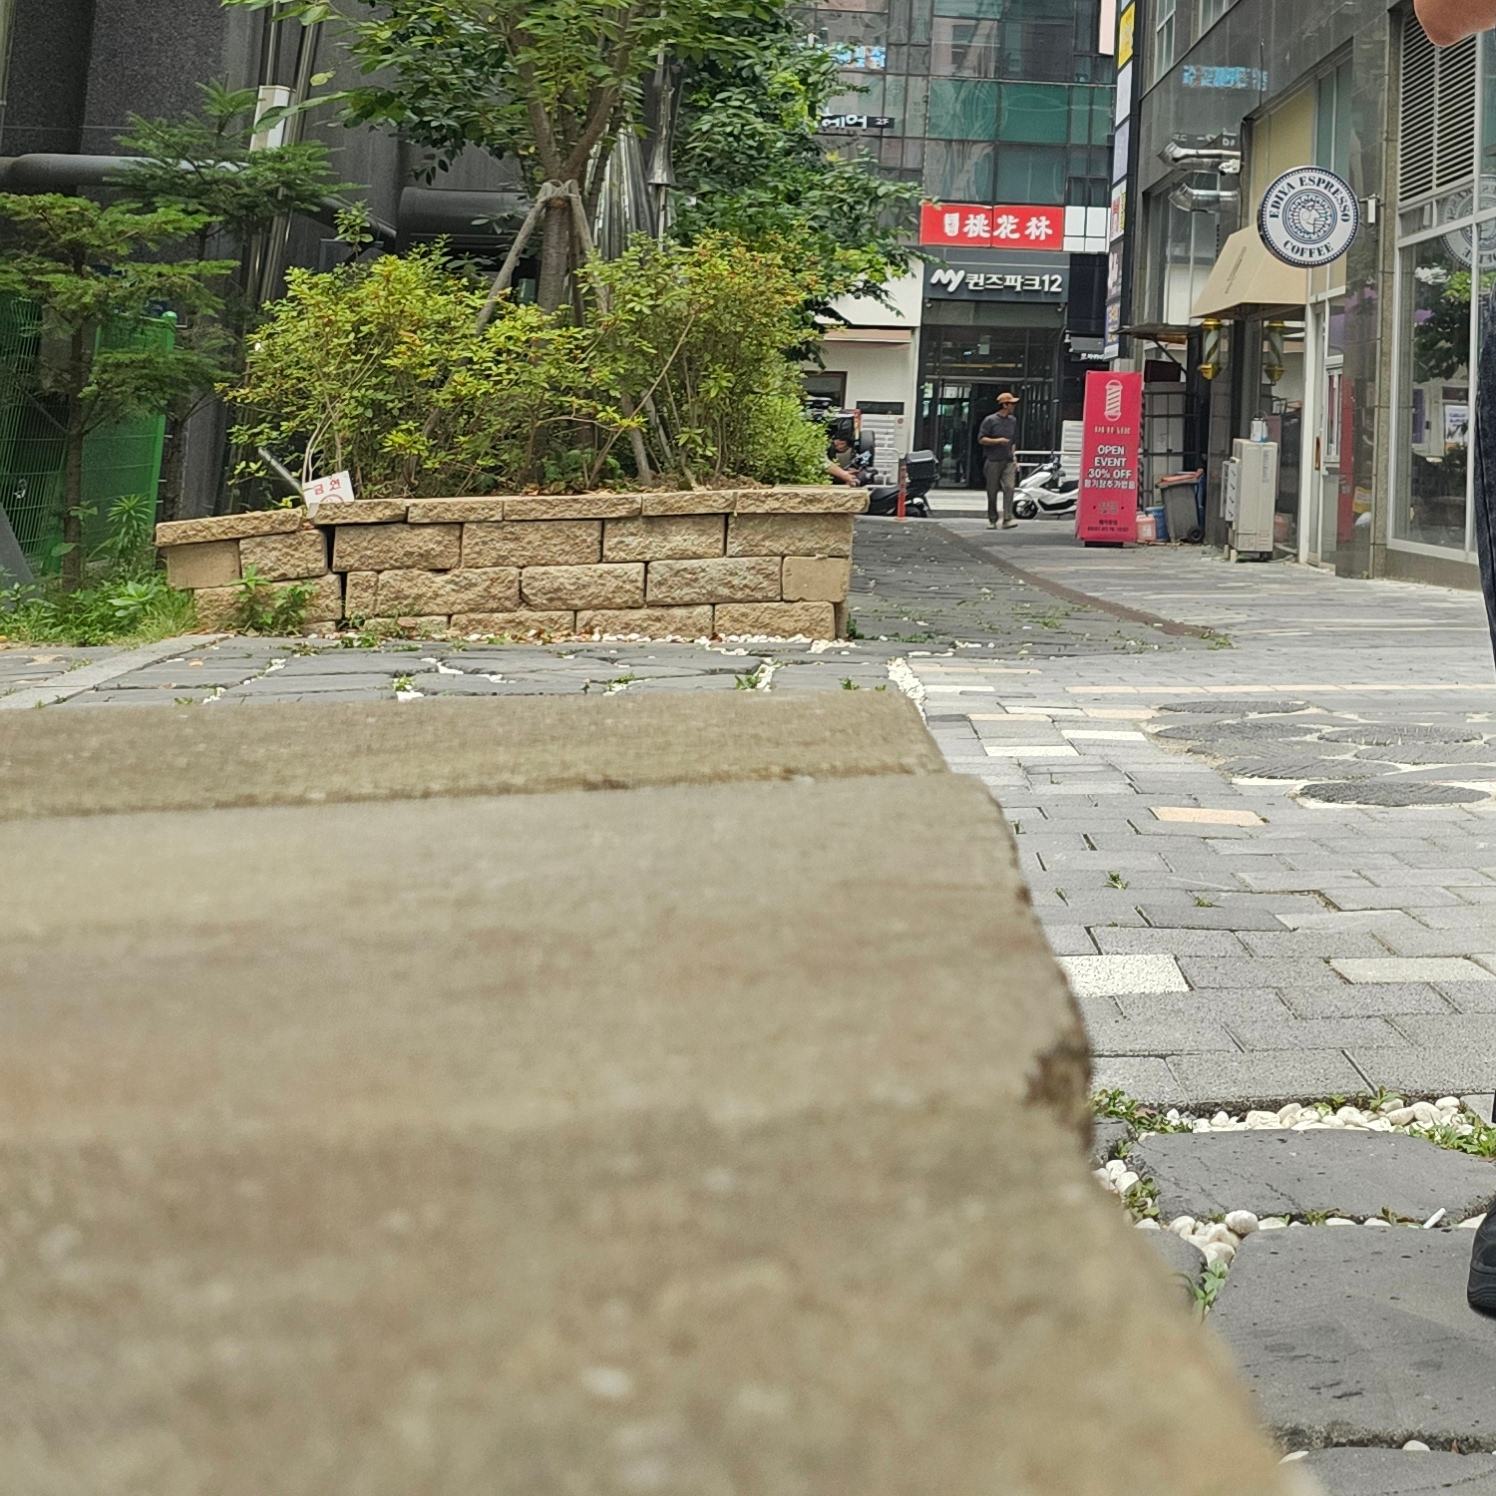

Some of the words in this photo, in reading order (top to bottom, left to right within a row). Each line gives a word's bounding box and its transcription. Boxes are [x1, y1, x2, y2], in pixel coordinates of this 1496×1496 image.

[1269, 182, 1296, 219] EDIYA
[1298, 175, 1351, 223] ESPRESSO
[1283, 239, 1334, 258] COFFEE
[965, 273, 1063, 292] 퀸즈파크12
[1097, 445, 1125, 455] OPEN
[1094, 457, 1128, 467] EVENT
[1088, 468, 1110, 479] 30%
[1113, 469, 1132, 480] OFF
